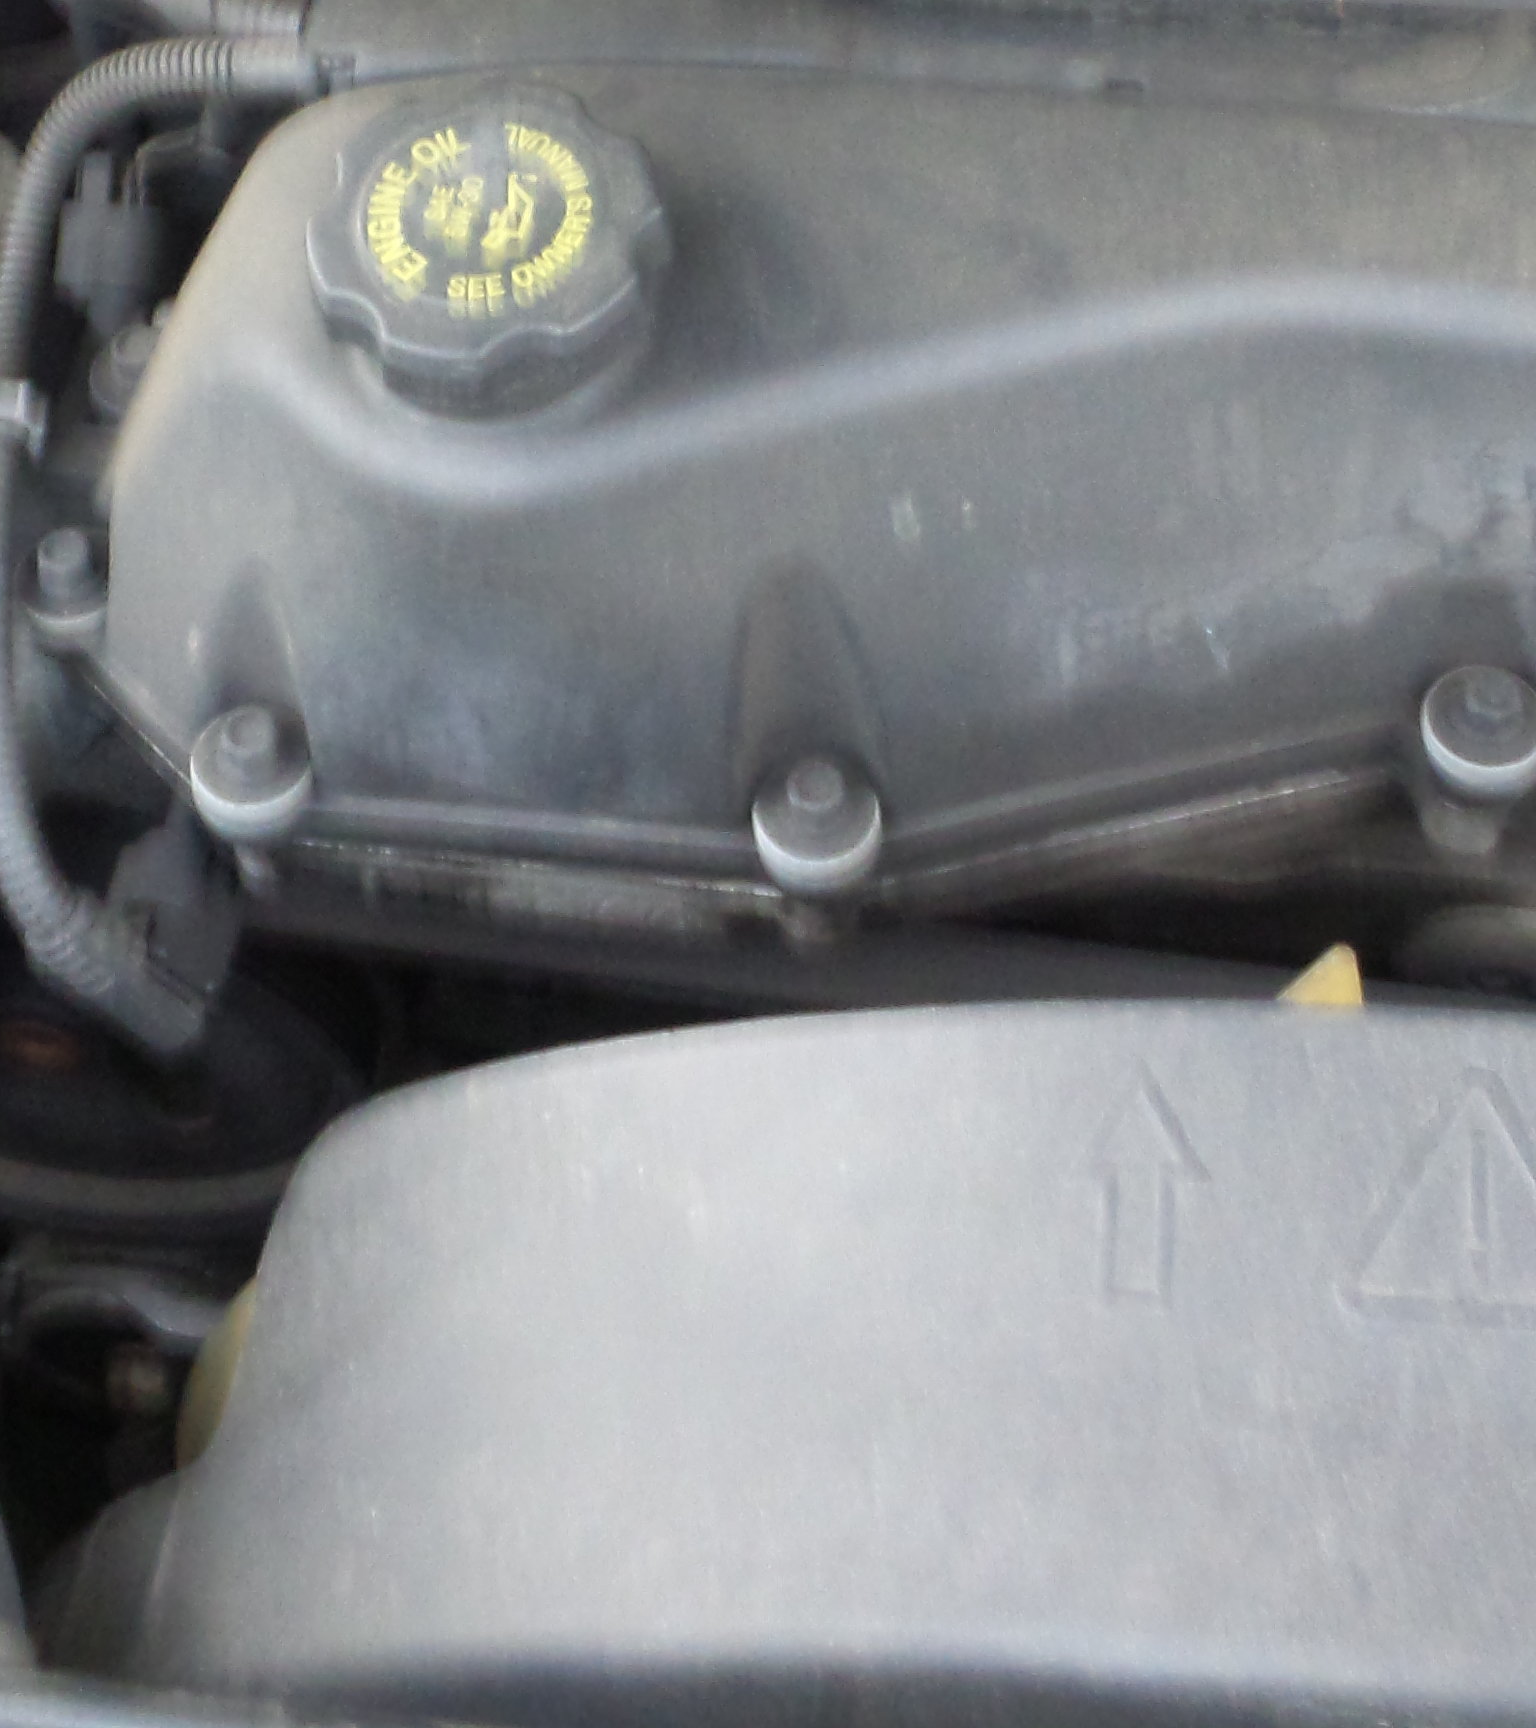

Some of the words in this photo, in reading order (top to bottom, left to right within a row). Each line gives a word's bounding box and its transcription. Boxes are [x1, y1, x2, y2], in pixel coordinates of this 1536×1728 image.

[367, 162, 428, 284] ENGINE
[411, 128, 472, 165] OIL
[447, 274, 505, 300] SEE
[505, 121, 589, 193] MANUAL
